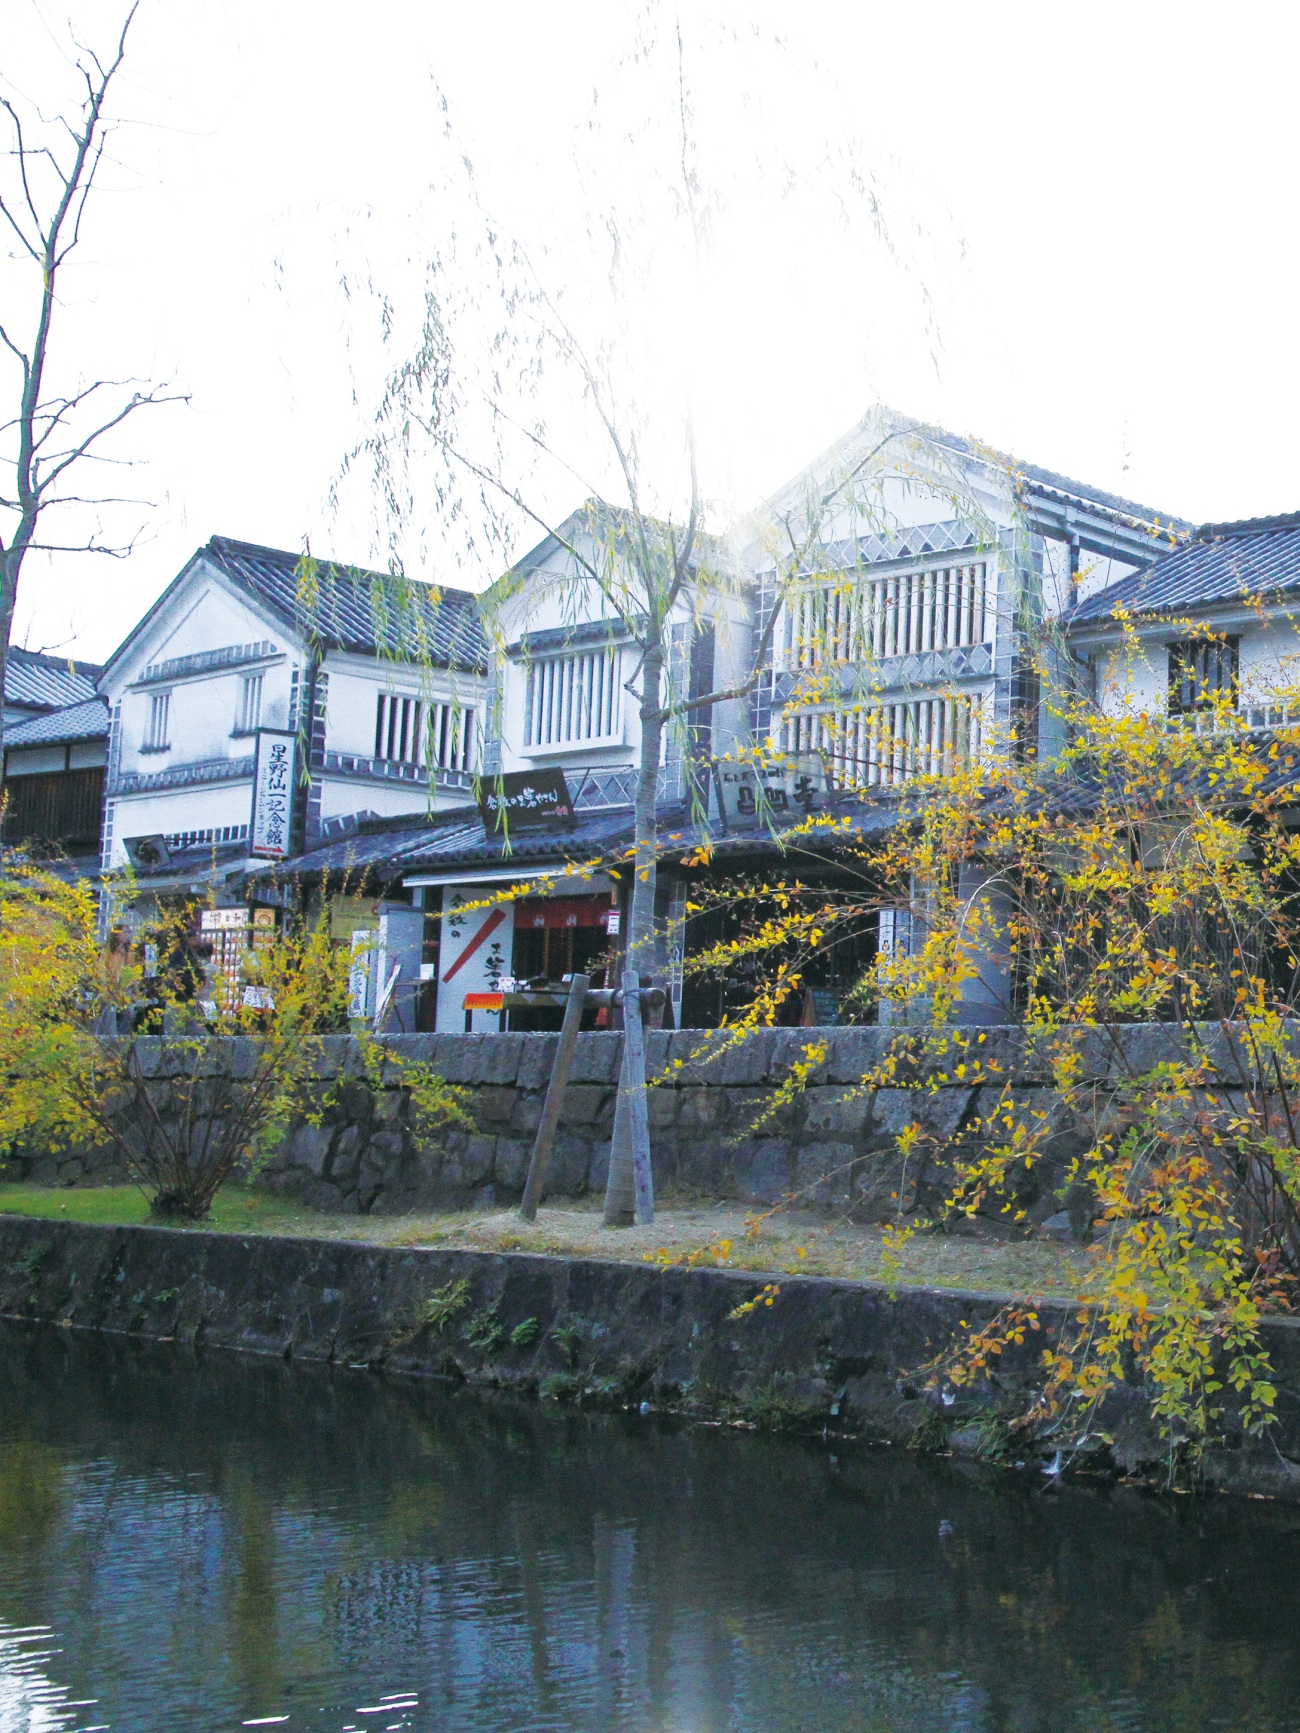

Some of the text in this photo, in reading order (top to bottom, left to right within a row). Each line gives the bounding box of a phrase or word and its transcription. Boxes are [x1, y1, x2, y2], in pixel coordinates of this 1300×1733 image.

[266, 743, 288, 845] 星野仙一記念館
[737, 775, 821, 814] 凸凹堂
